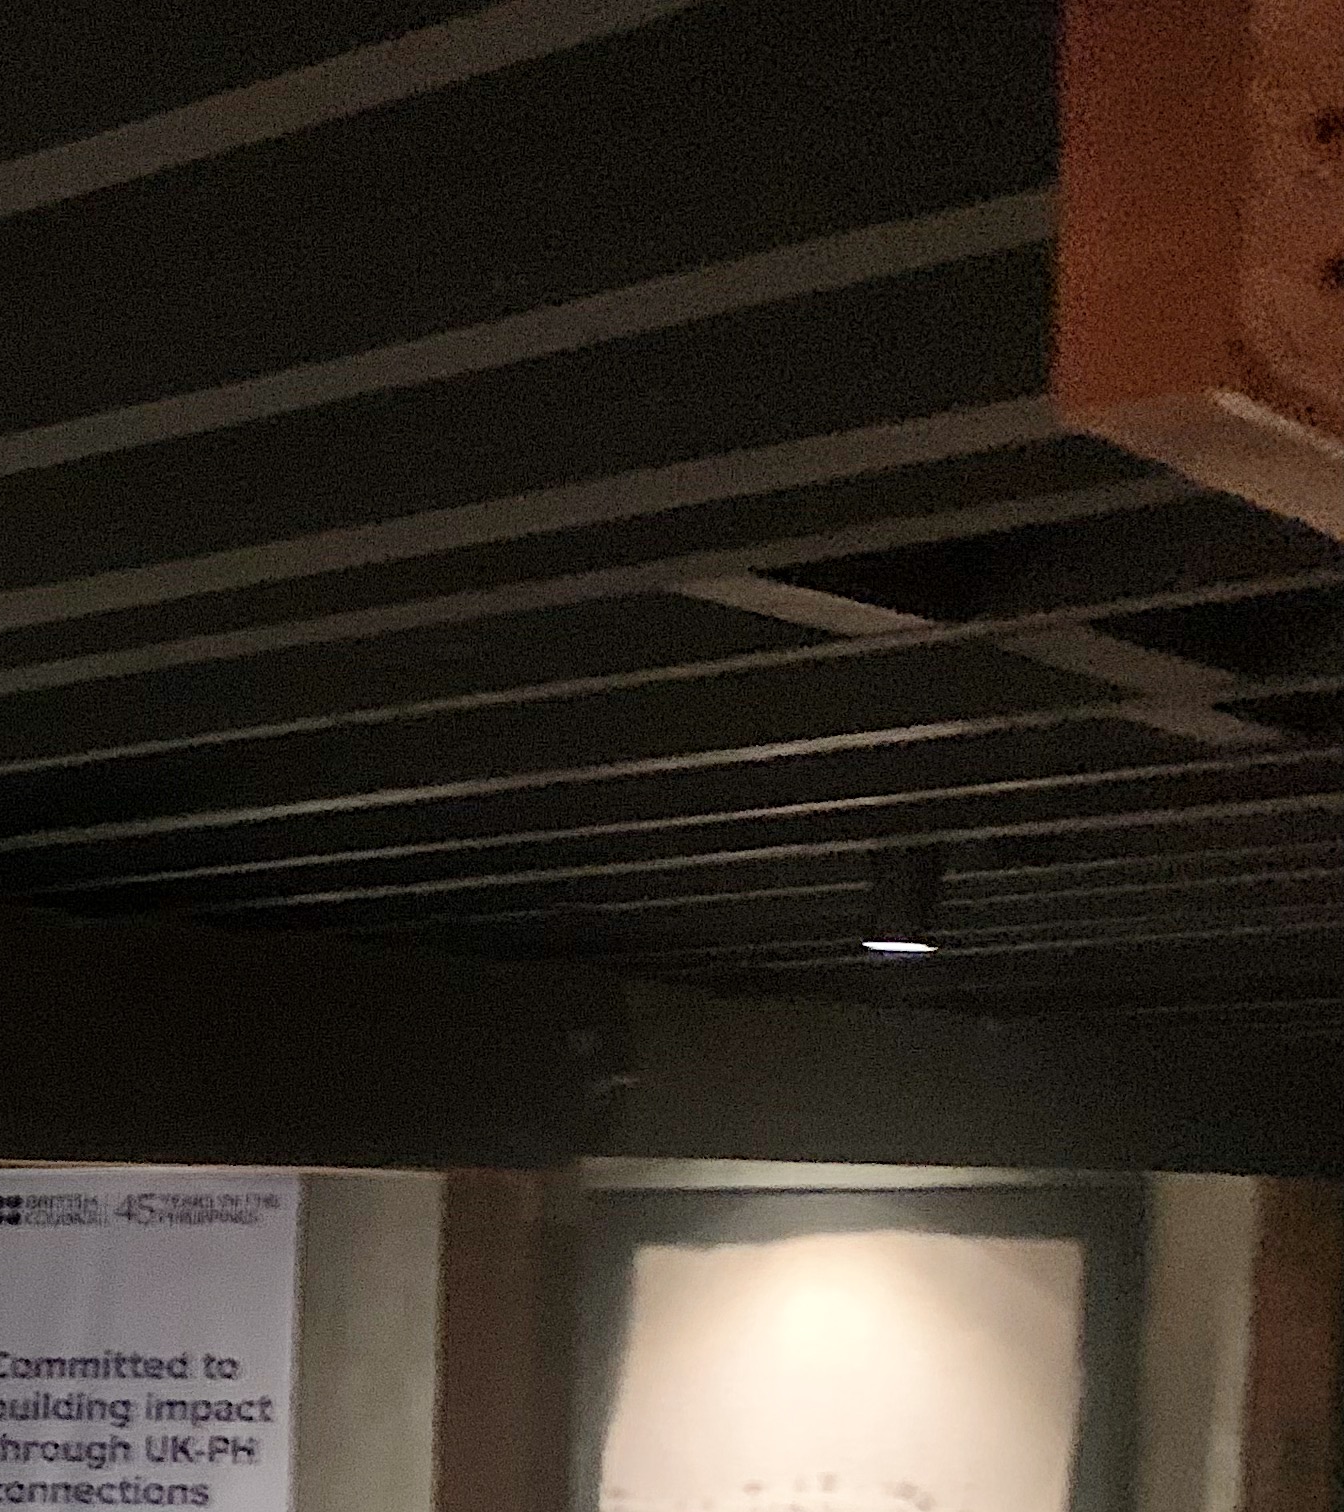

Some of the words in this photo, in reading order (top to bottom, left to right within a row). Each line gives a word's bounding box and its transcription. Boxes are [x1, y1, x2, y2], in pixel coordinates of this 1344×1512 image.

[204, 1354, 239, 1380] to
[146, 1394, 273, 1427] impact
[145, 1435, 257, 1462] UK-PH
